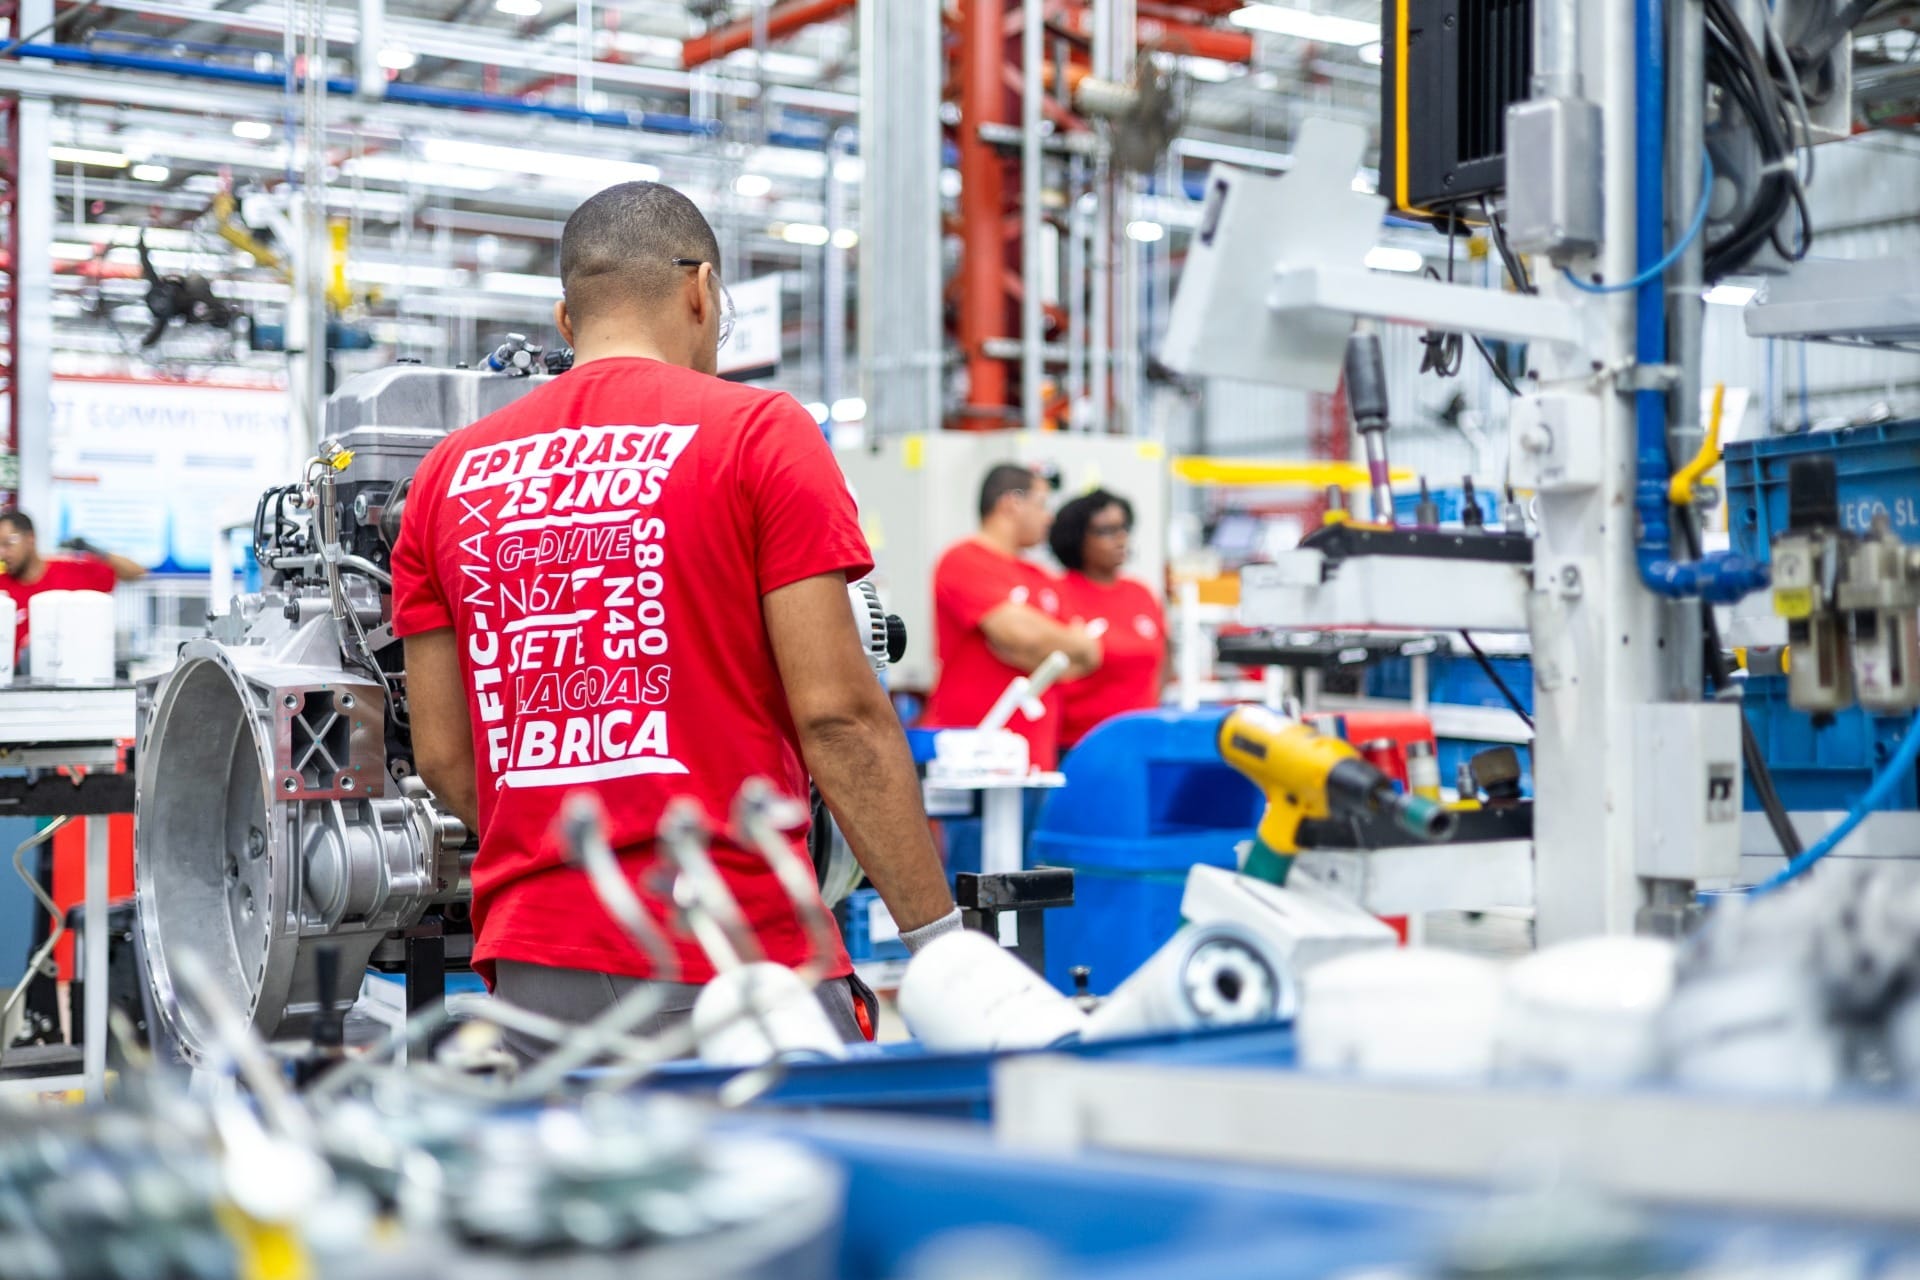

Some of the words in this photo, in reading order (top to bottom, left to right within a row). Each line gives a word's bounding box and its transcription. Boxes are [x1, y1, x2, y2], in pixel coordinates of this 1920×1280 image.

[460, 443, 536, 486] FPT
[538, 431, 672, 470] BRASIL
[497, 478, 552, 519] 25
[553, 468, 669, 511] ANOS
[499, 573, 570, 619] N67
[632, 518, 669, 657] S8000
[602, 576, 637, 660] N45
[507, 625, 586, 674] SETE
[515, 664, 672, 715] LAGOAS
[487, 709, 670, 773] FBRICA
